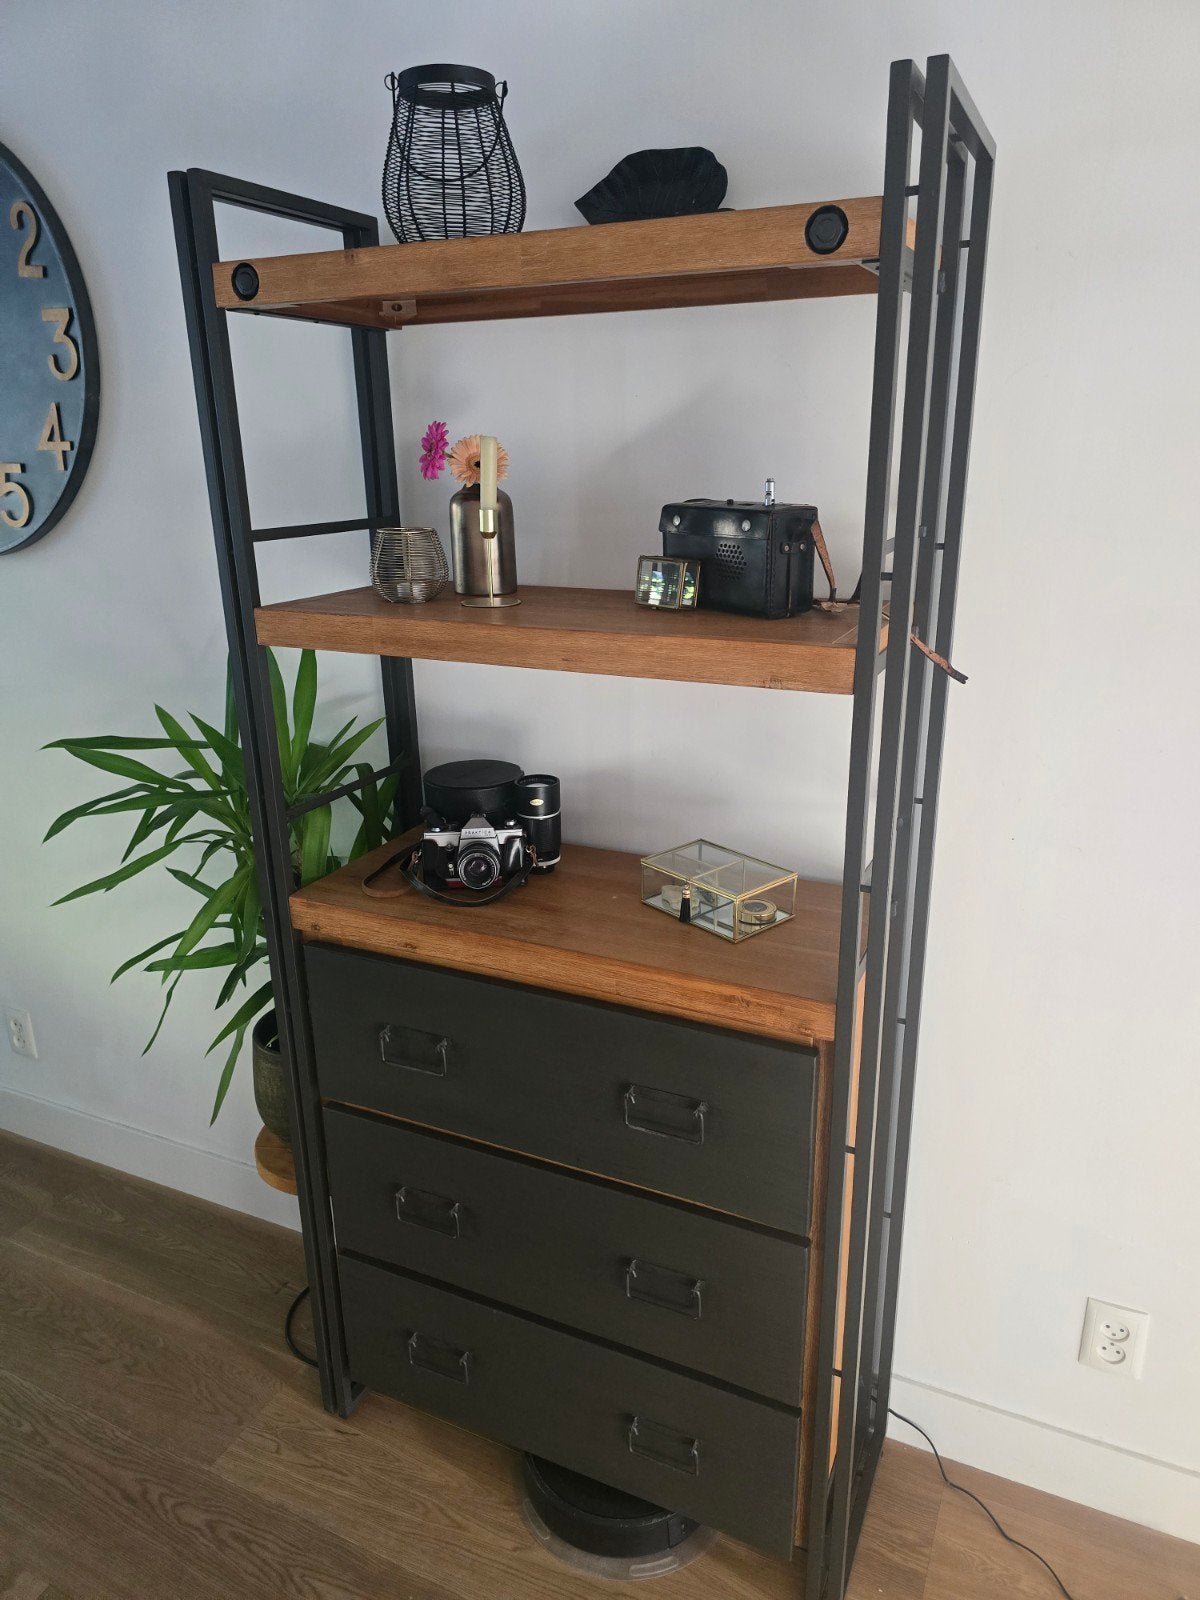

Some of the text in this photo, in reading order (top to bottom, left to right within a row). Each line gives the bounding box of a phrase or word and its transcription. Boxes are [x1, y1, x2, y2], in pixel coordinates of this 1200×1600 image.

[10, 201, 46, 278] 2
[41, 307, 79, 381] 3
[36, 402, 73, 471] 4
[0, 463, 31, 528] 5
